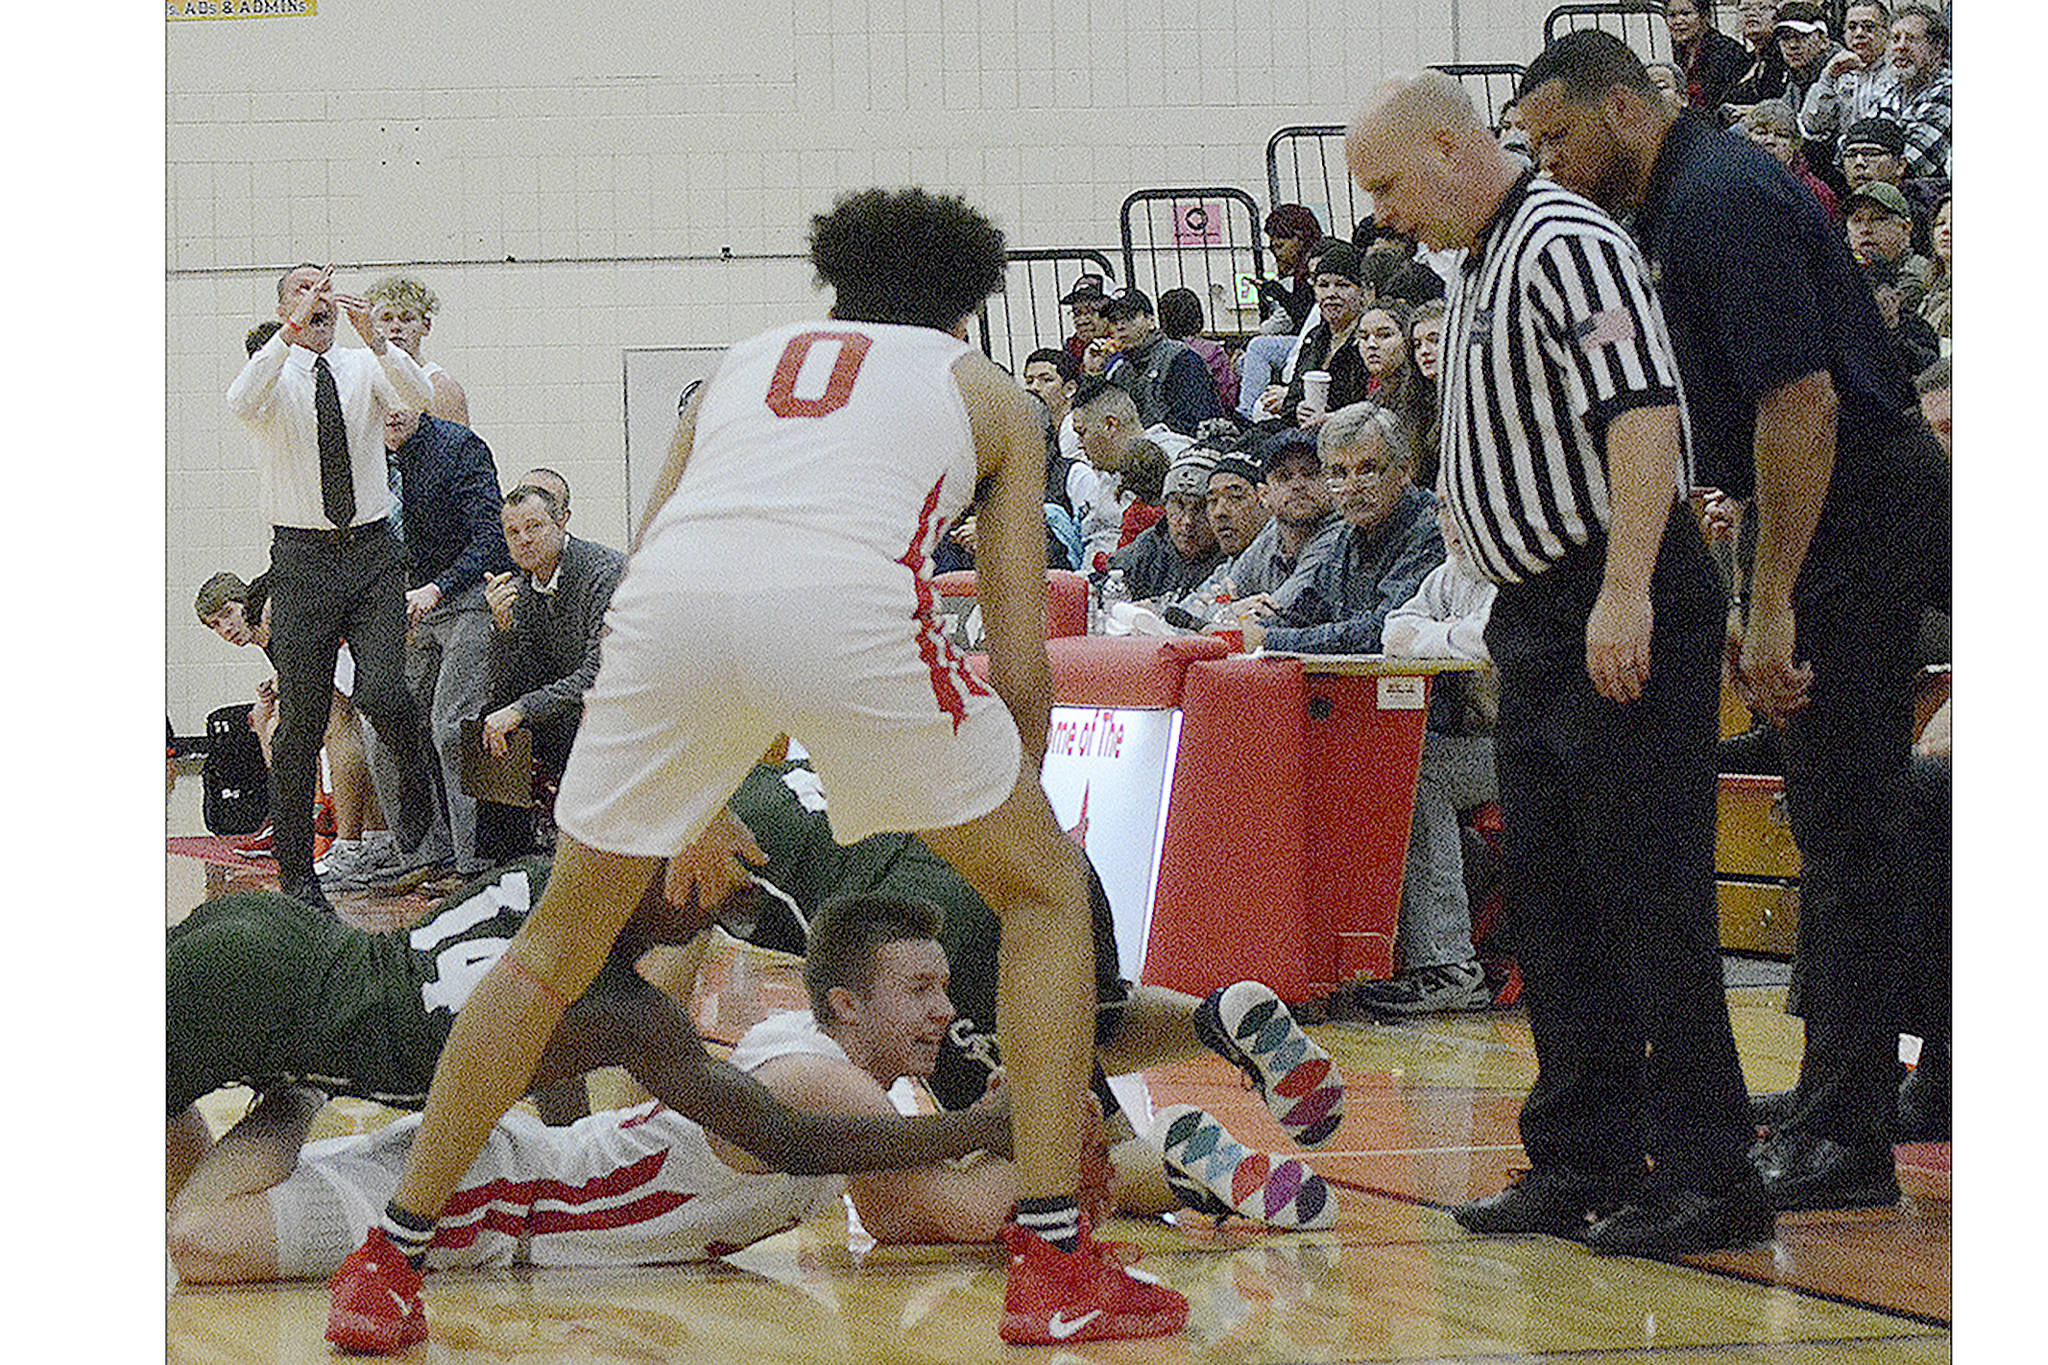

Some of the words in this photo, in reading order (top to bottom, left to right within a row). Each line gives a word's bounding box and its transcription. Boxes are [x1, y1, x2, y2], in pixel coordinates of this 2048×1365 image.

[184, 1, 218, 15] ADs
[222, 1, 233, 15] &
[239, 0, 307, 13] ADMINs
[765, 331, 874, 418] 0
[1048, 721, 1077, 756] me
[1079, 708, 1100, 757] of
[1097, 709, 1124, 758] The
